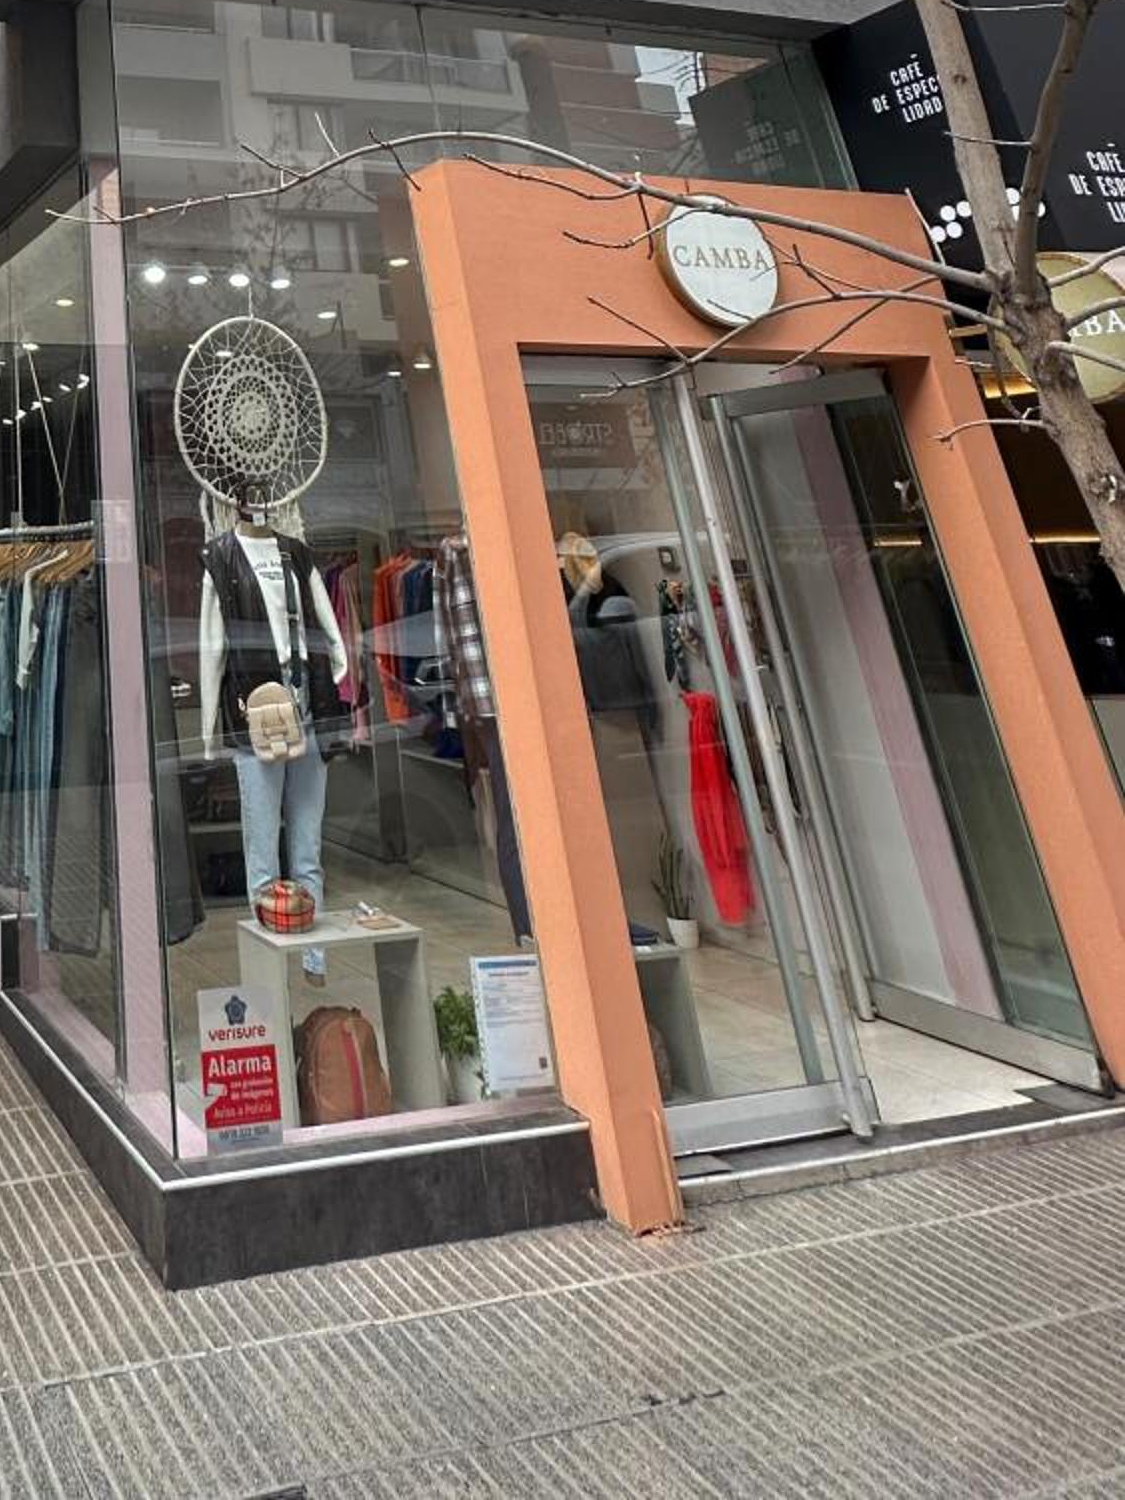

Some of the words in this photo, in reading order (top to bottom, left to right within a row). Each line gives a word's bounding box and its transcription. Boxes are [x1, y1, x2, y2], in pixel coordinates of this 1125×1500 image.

[872, 93, 890, 114] DE
[896, 75, 940, 105] ESPEC
[902, 96, 943, 123] LIDAD
[1068, 173, 1093, 195] DE
[673, 244, 769, 271] CAMBA
[208, 1024, 266, 1042] verisure
[208, 1055, 272, 1078] Alarma
